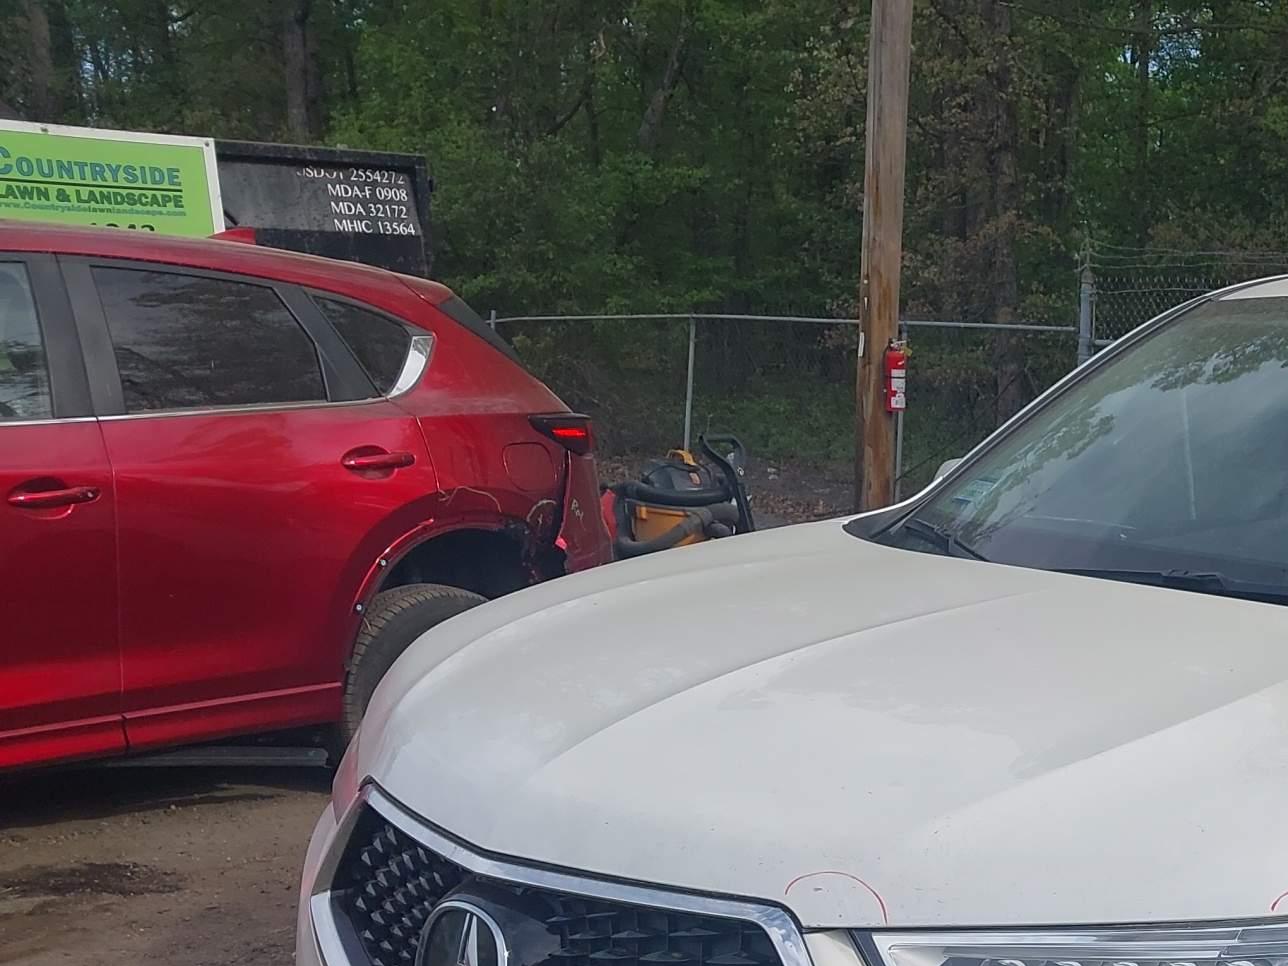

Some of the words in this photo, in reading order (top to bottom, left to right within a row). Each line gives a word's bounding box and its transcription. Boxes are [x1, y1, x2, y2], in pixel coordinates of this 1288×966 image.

[350, 167, 405, 185] 2554272
[56, 188, 70, 203] &
[75, 189, 184, 209] LANDSCAPE
[327, 183, 373, 199] MDA-F
[375, 187, 408, 202] 0908
[330, 201, 367, 216] MDA
[367, 203, 408, 219] 32172
[333, 218, 373, 234] MHIC
[377, 221, 416, 236] 13564
